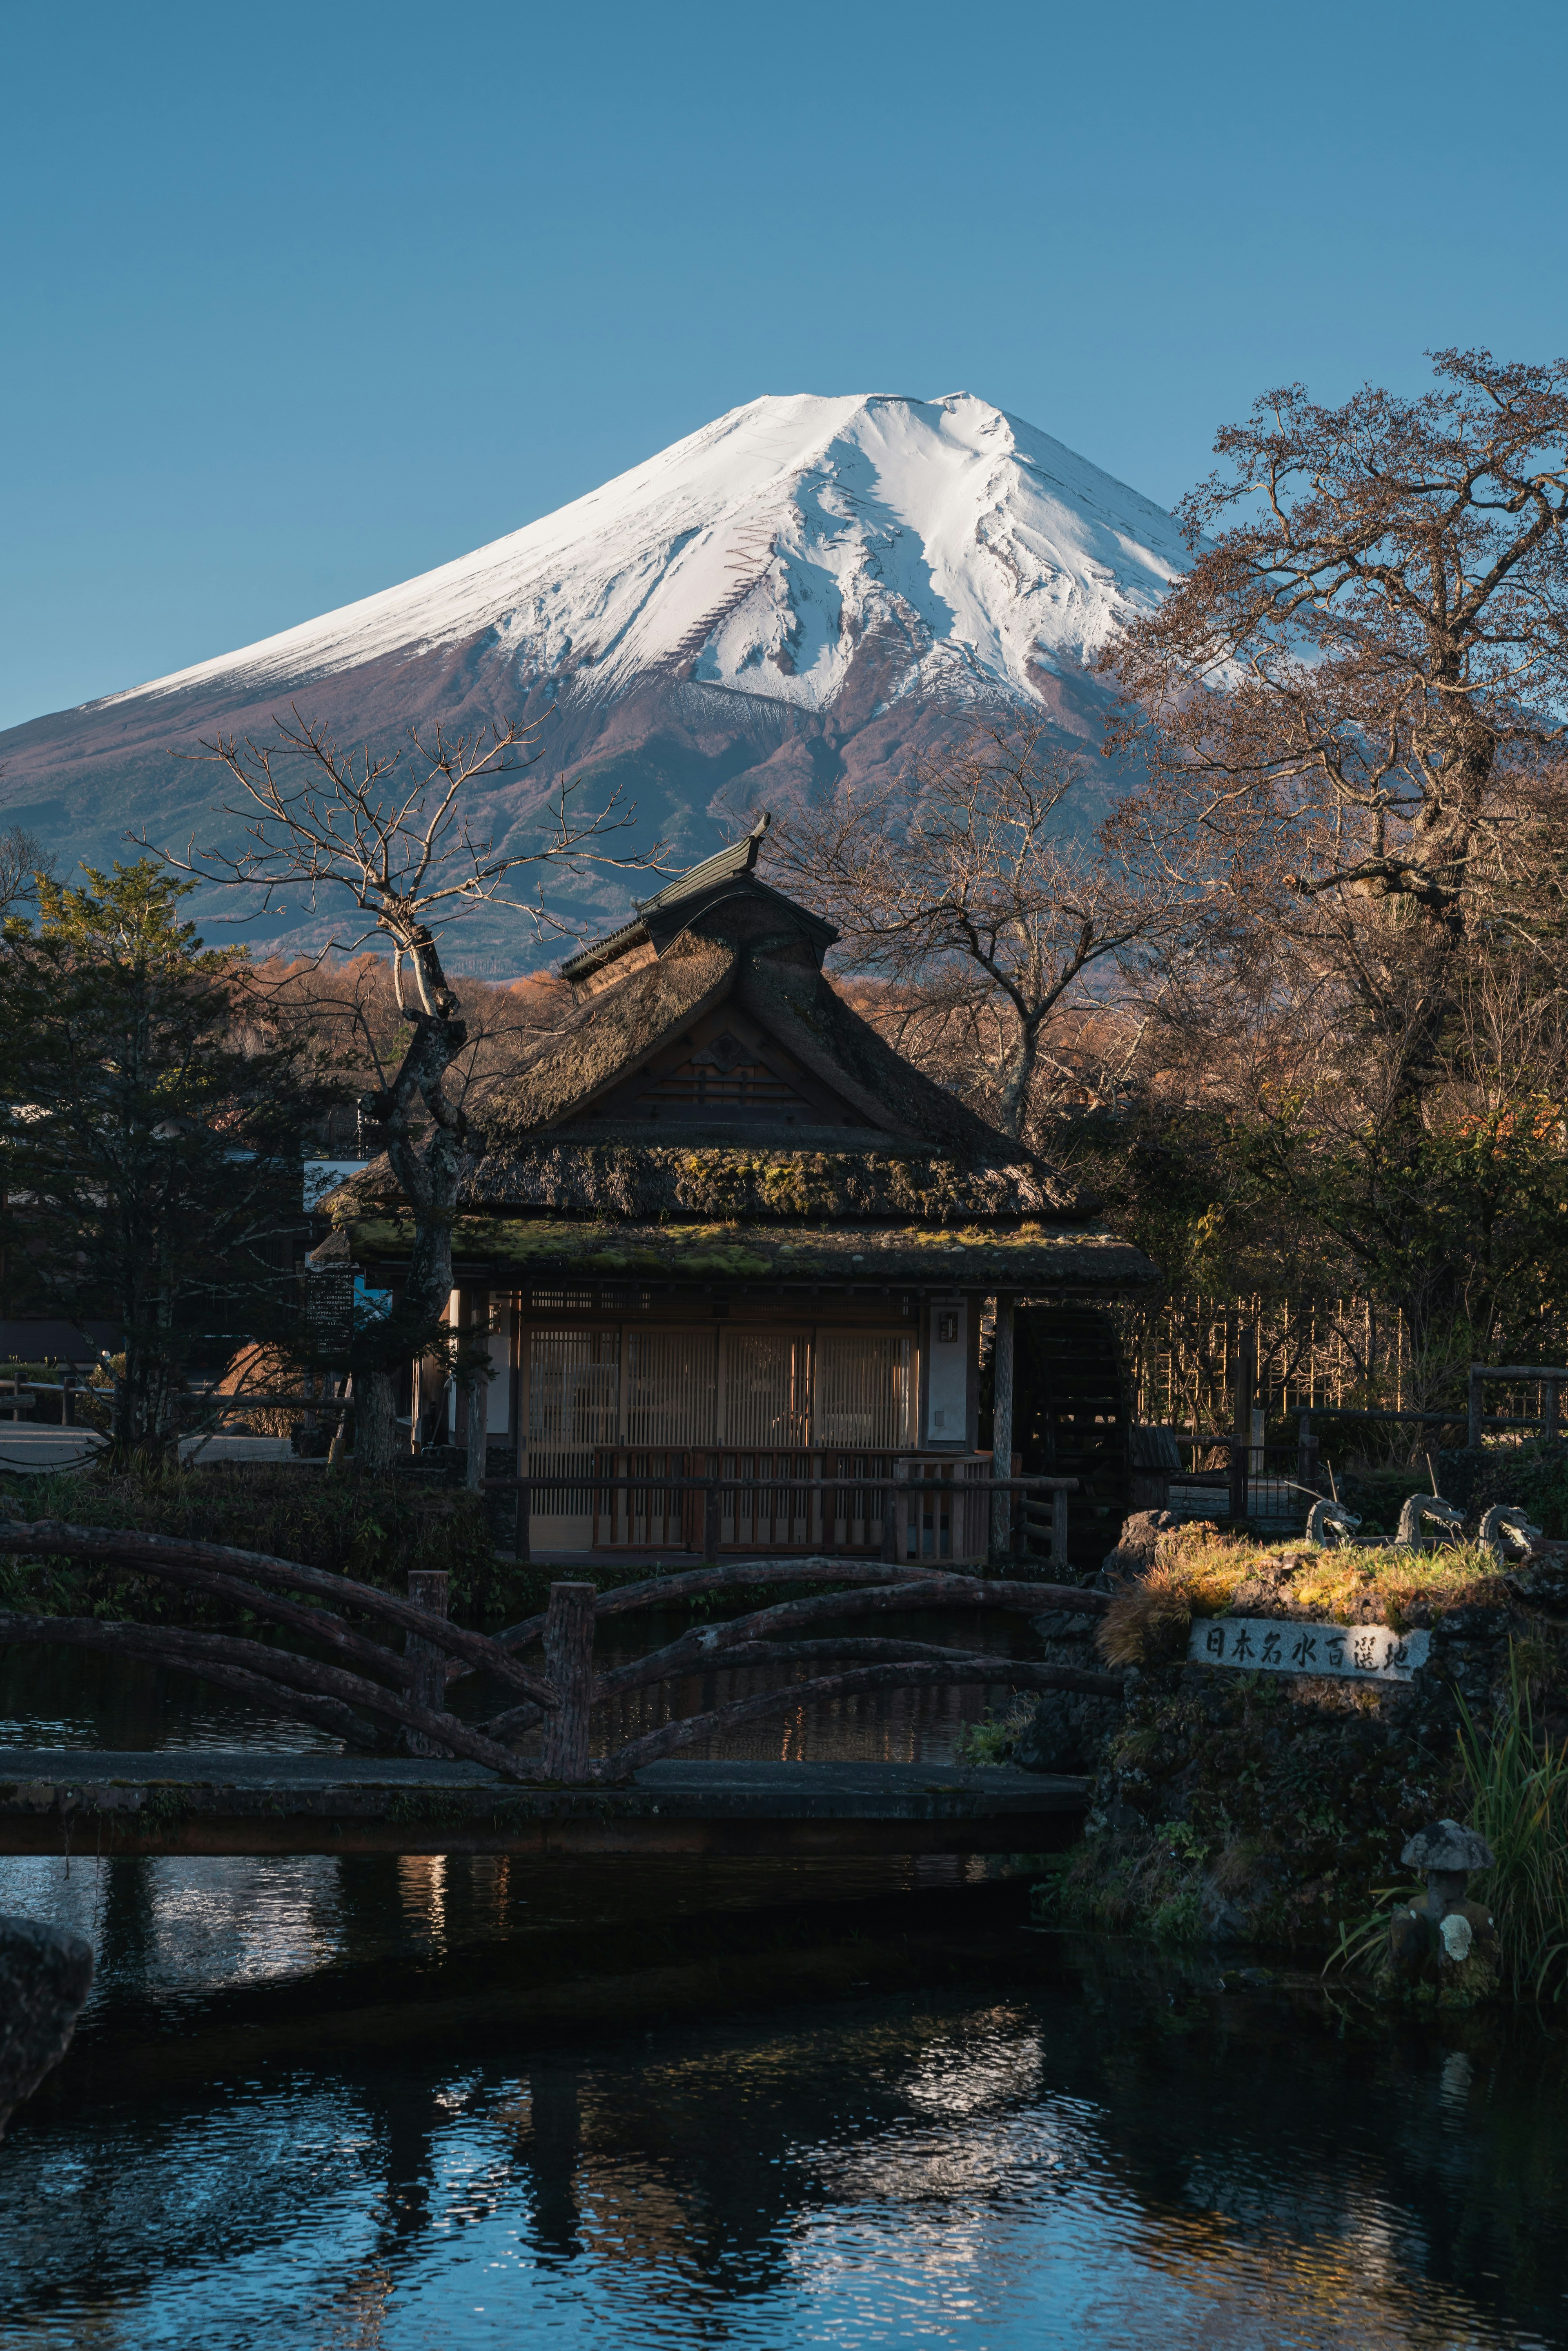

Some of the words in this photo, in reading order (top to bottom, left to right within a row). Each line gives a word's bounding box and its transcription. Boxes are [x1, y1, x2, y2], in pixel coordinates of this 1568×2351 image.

[1206, 1627, 1411, 1671] 日本名水百選地
